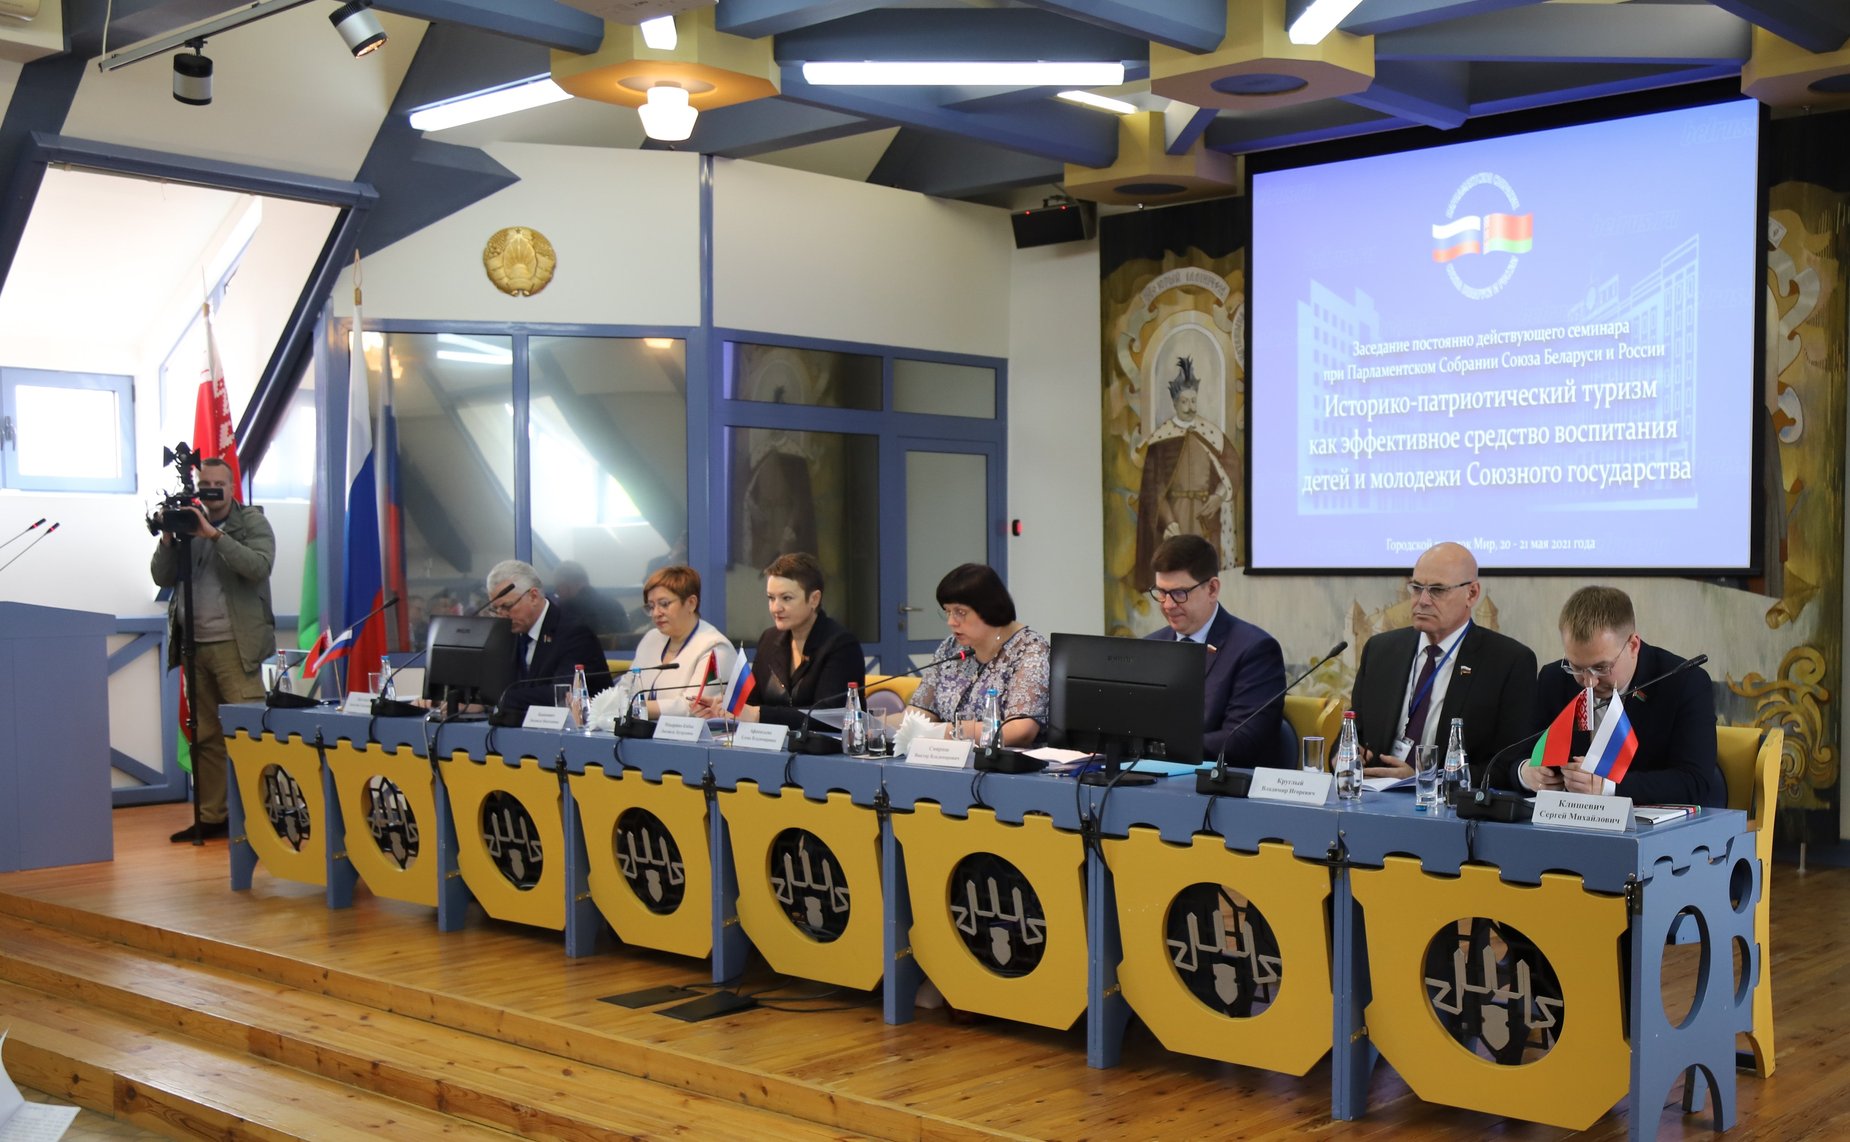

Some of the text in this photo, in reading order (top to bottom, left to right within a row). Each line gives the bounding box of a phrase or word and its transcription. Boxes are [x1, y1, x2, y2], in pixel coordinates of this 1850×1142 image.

[1353, 321, 1630, 357] Заседание постоянно действующего семинара
[1323, 342, 1665, 385] при Парламентском Собрании Союза Беларуси и России
[1324, 378, 1658, 422] Историко-патриотический туризм
[1308, 419, 1678, 459] как эффективное средство воспитания
[1301, 460, 1692, 494] детей и молодежи Союзного государства
[1386, 537, 1433, 554] Городской
[1474, 536, 1498, 554] Мир,
[1500, 540, 1511, 550] 20
[1519, 540, 1529, 550] 21
[1530, 539, 1549, 550] мая
[1551, 539, 1571, 550] 2021
[1573, 538, 1596, 551] года
[1261, 785, 1316, 796] Владимир Игоревич
[1277, 777, 1304, 787] Круглый
[1539, 809, 1621, 825] Сергей Михайлович
[1558, 799, 1605, 811] Клишевич
